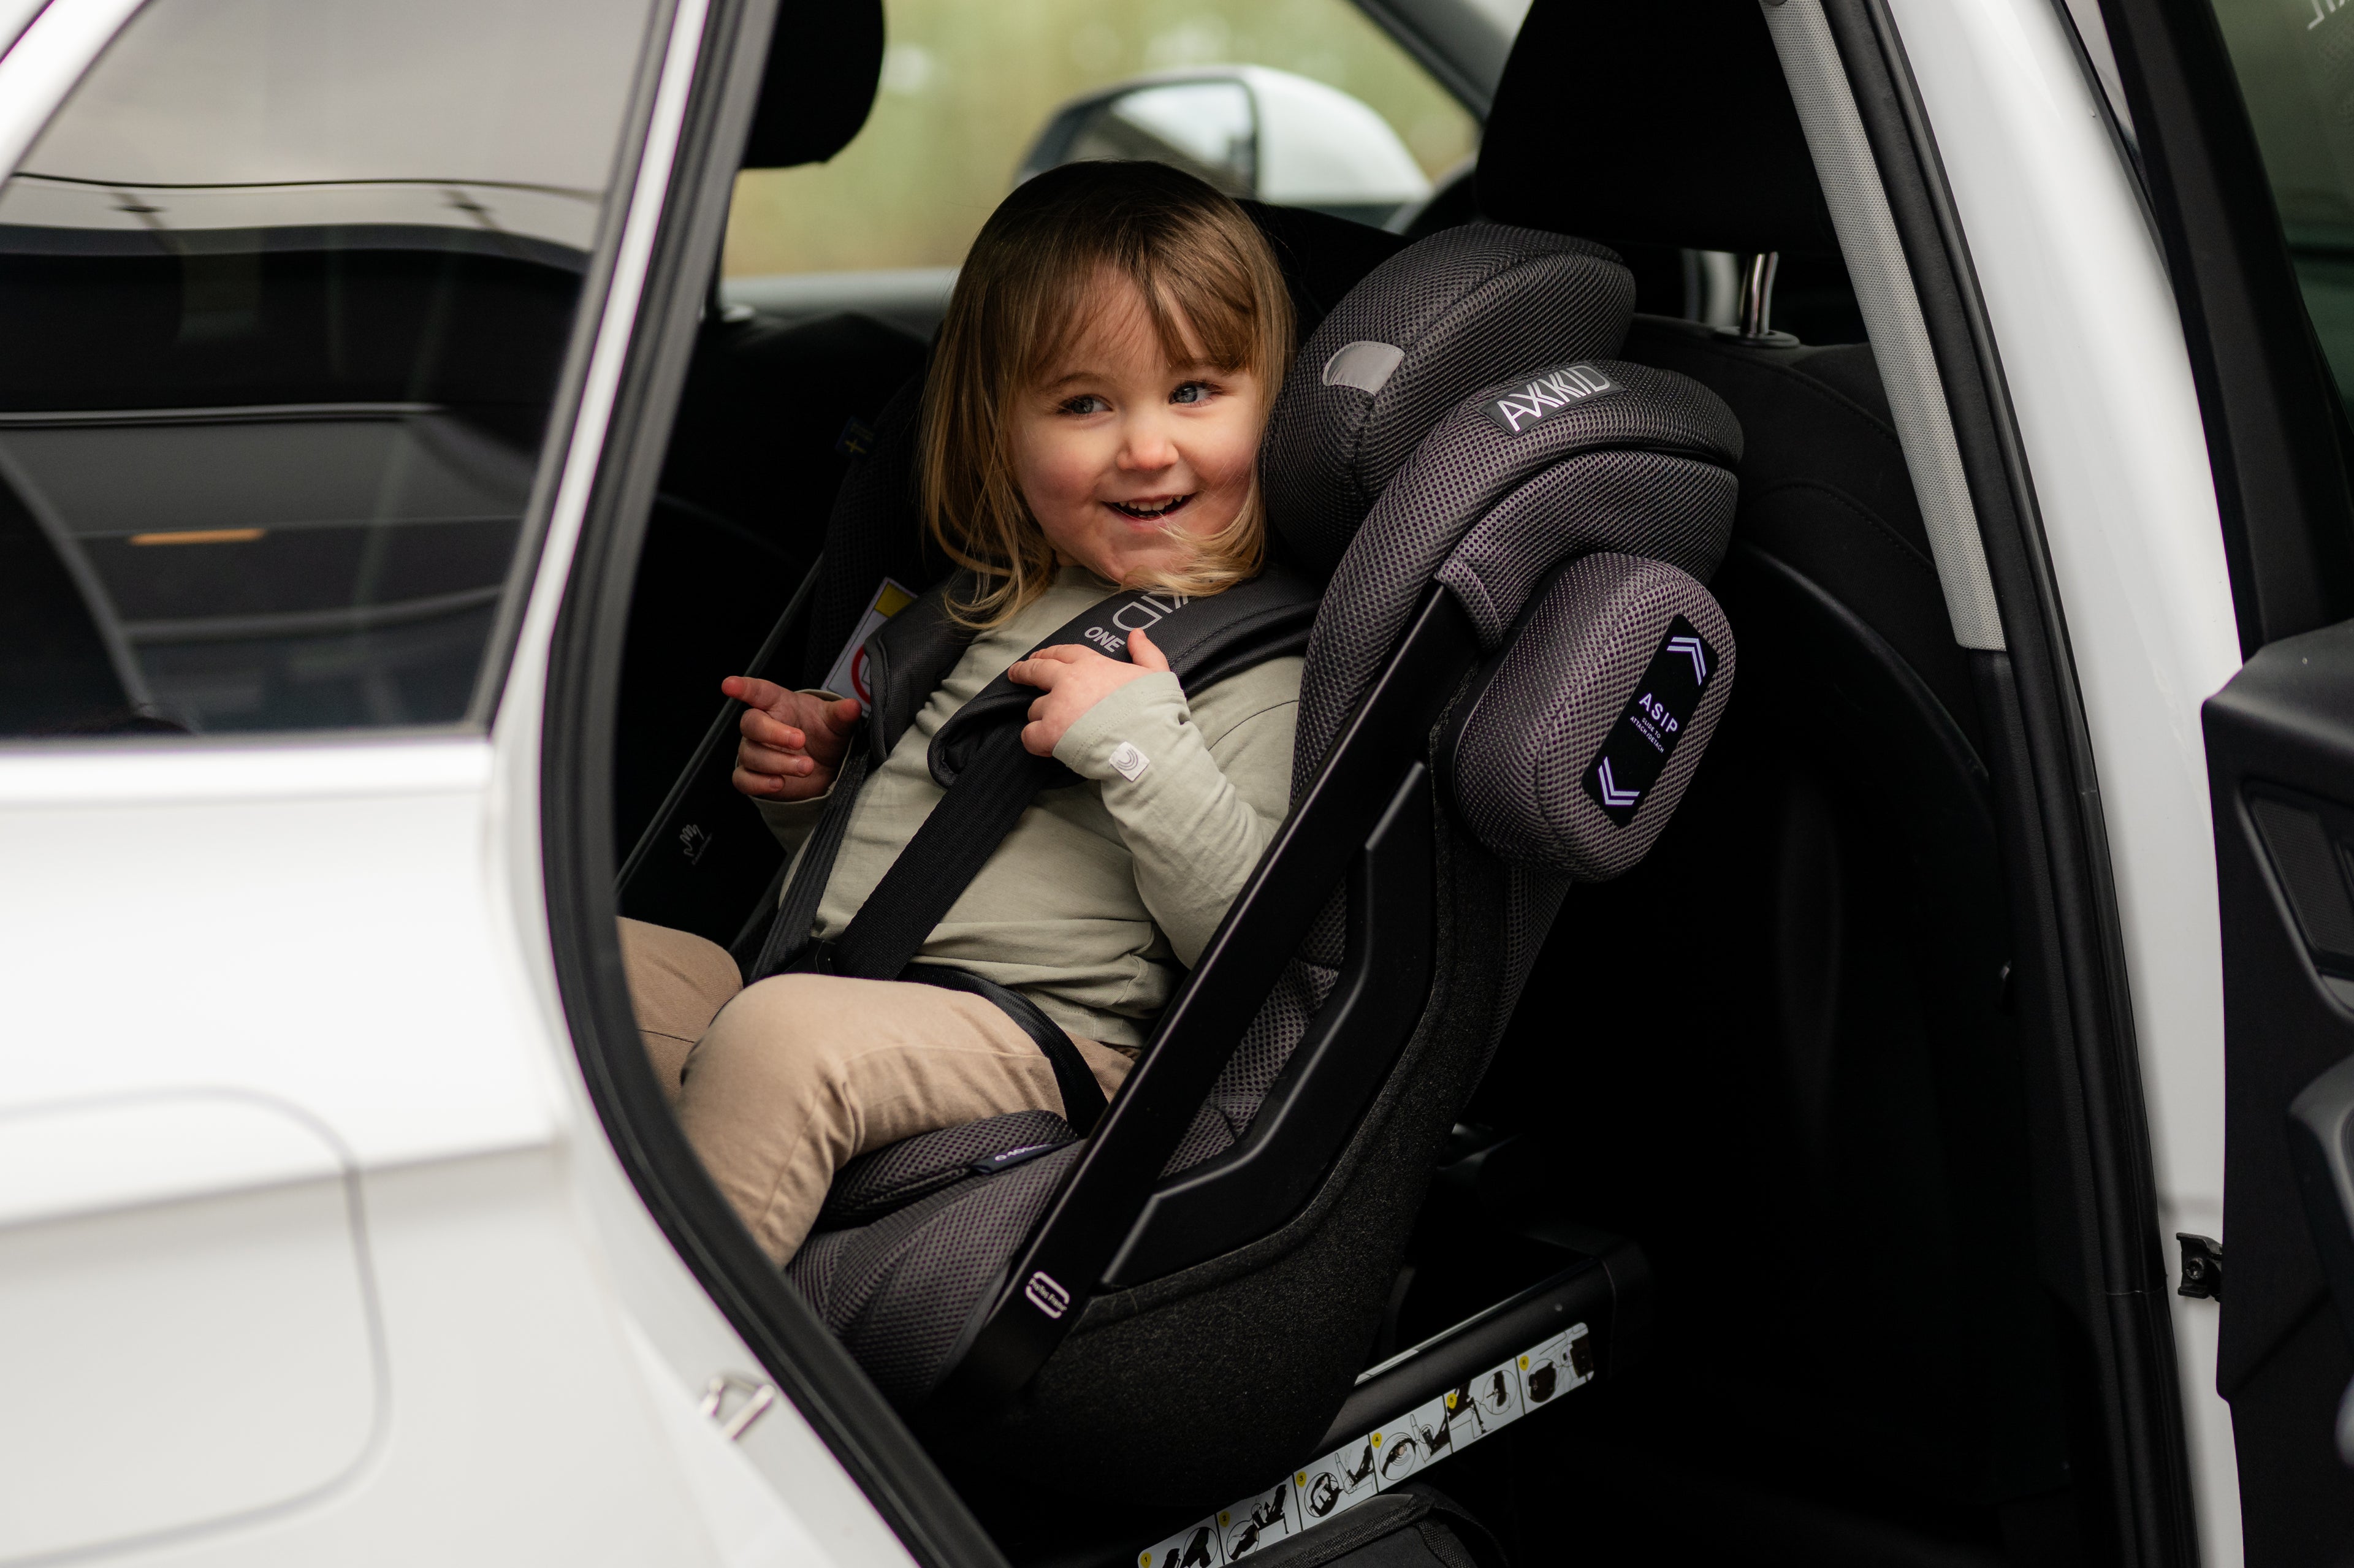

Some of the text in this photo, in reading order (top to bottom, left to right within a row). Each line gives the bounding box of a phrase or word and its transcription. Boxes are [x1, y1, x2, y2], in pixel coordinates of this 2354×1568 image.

[1084, 626, 1126, 653] ONE
[1639, 693, 1678, 733] ASIP
[1629, 716, 1648, 735] ATTACH
[1655, 730, 1661, 739] TO
